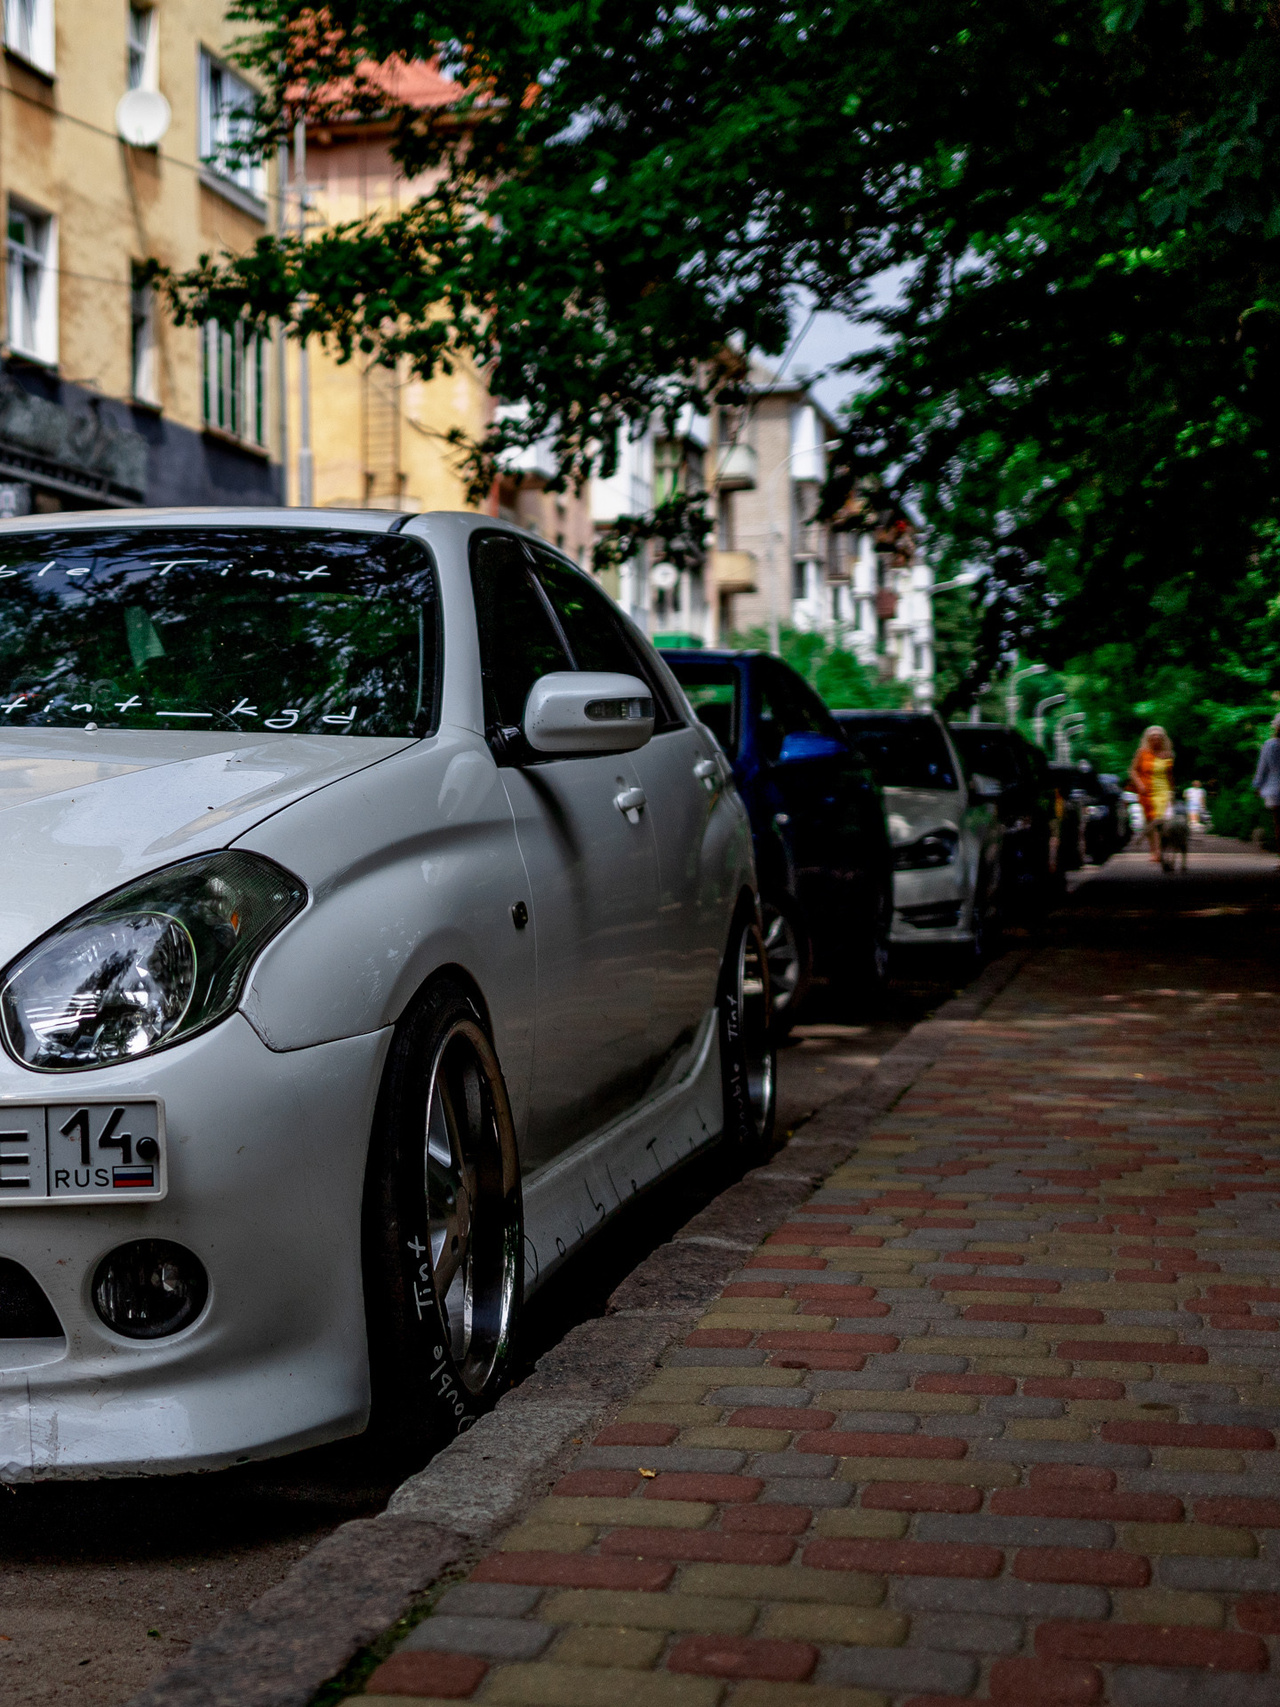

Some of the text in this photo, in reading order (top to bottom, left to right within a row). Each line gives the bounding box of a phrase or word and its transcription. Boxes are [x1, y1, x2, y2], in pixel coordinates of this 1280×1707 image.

[149, 559, 332, 581] Tint
[59, 1106, 134, 1166] 14
[54, 1167, 111, 1190] RUS
[406, 1234, 434, 1320] Tint
